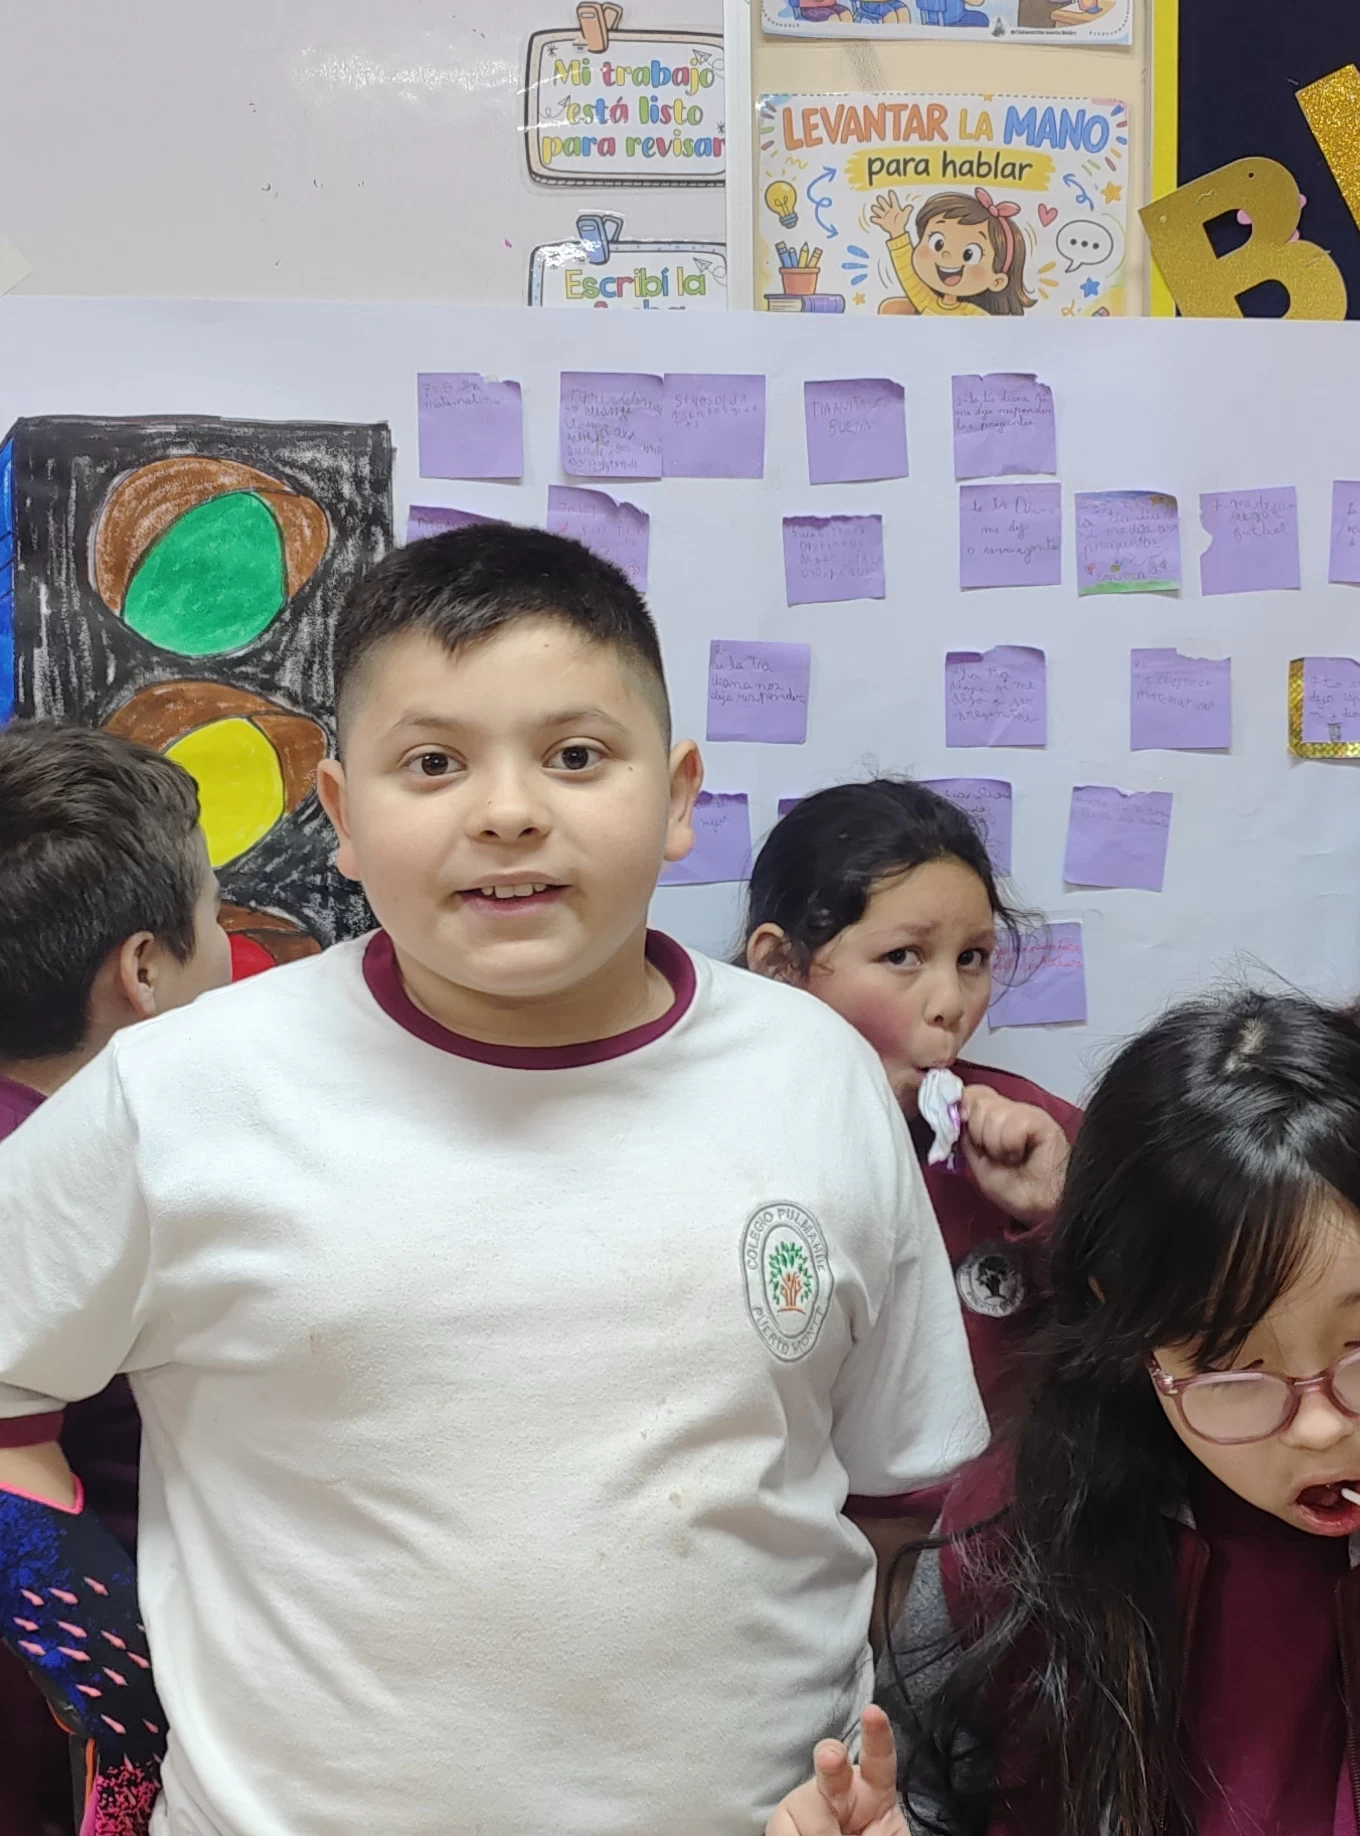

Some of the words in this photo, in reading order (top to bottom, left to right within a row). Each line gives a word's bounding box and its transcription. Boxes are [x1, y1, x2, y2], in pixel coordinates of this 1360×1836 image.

[552, 57, 592, 88] Mi
[601, 58, 715, 97] trabajo
[565, 96, 629, 127] está
[638, 95, 704, 127] listo
[783, 102, 948, 150] LEVANTAR
[959, 107, 994, 141] LA
[1003, 105, 1110, 152] MANO
[542, 134, 616, 164] para
[626, 130, 725, 159] revisar
[867, 154, 930, 186] para
[941, 148, 1034, 182] hablar
[565, 266, 670, 300] Escribí
[676, 266, 706, 297] la
[747, 1210, 774, 1271] COLEGIO
